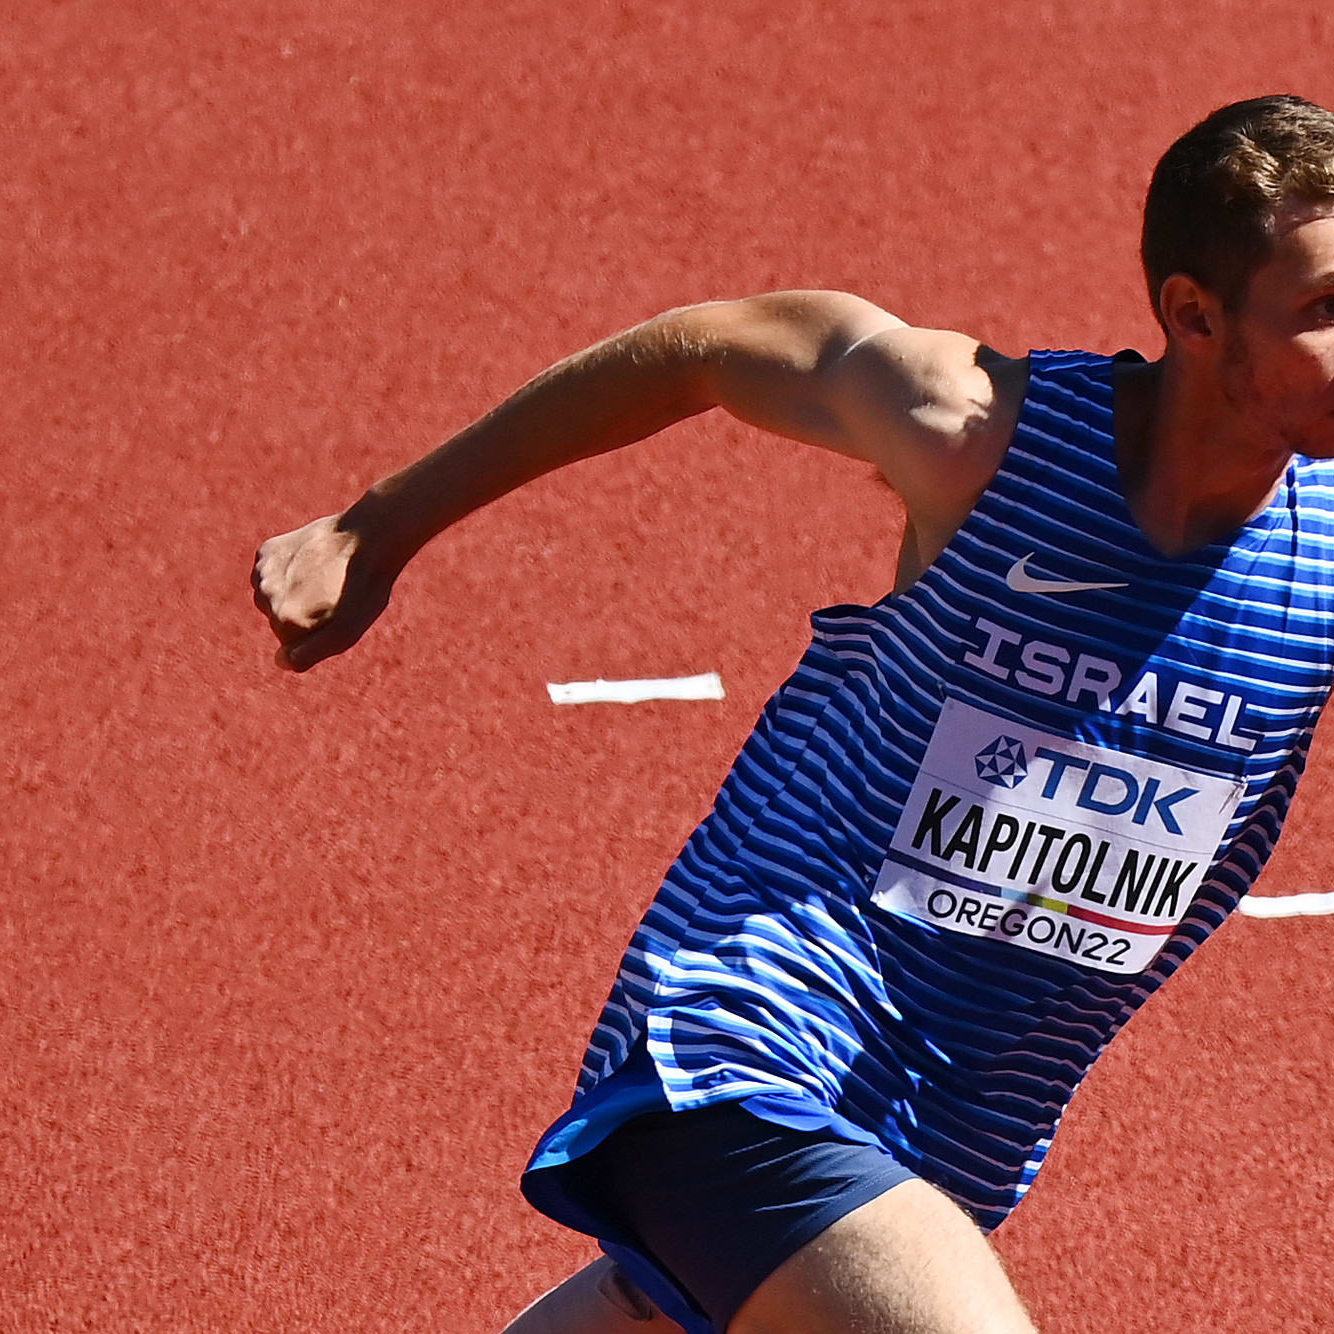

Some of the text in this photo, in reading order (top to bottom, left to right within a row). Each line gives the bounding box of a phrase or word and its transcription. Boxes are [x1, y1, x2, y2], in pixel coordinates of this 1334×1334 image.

[965, 616, 1267, 752] ISRAEL
[1034, 746, 1201, 836] TDK
[911, 787, 1199, 919] KAPITOLNIK
[927, 889, 1132, 966] OREGON22
